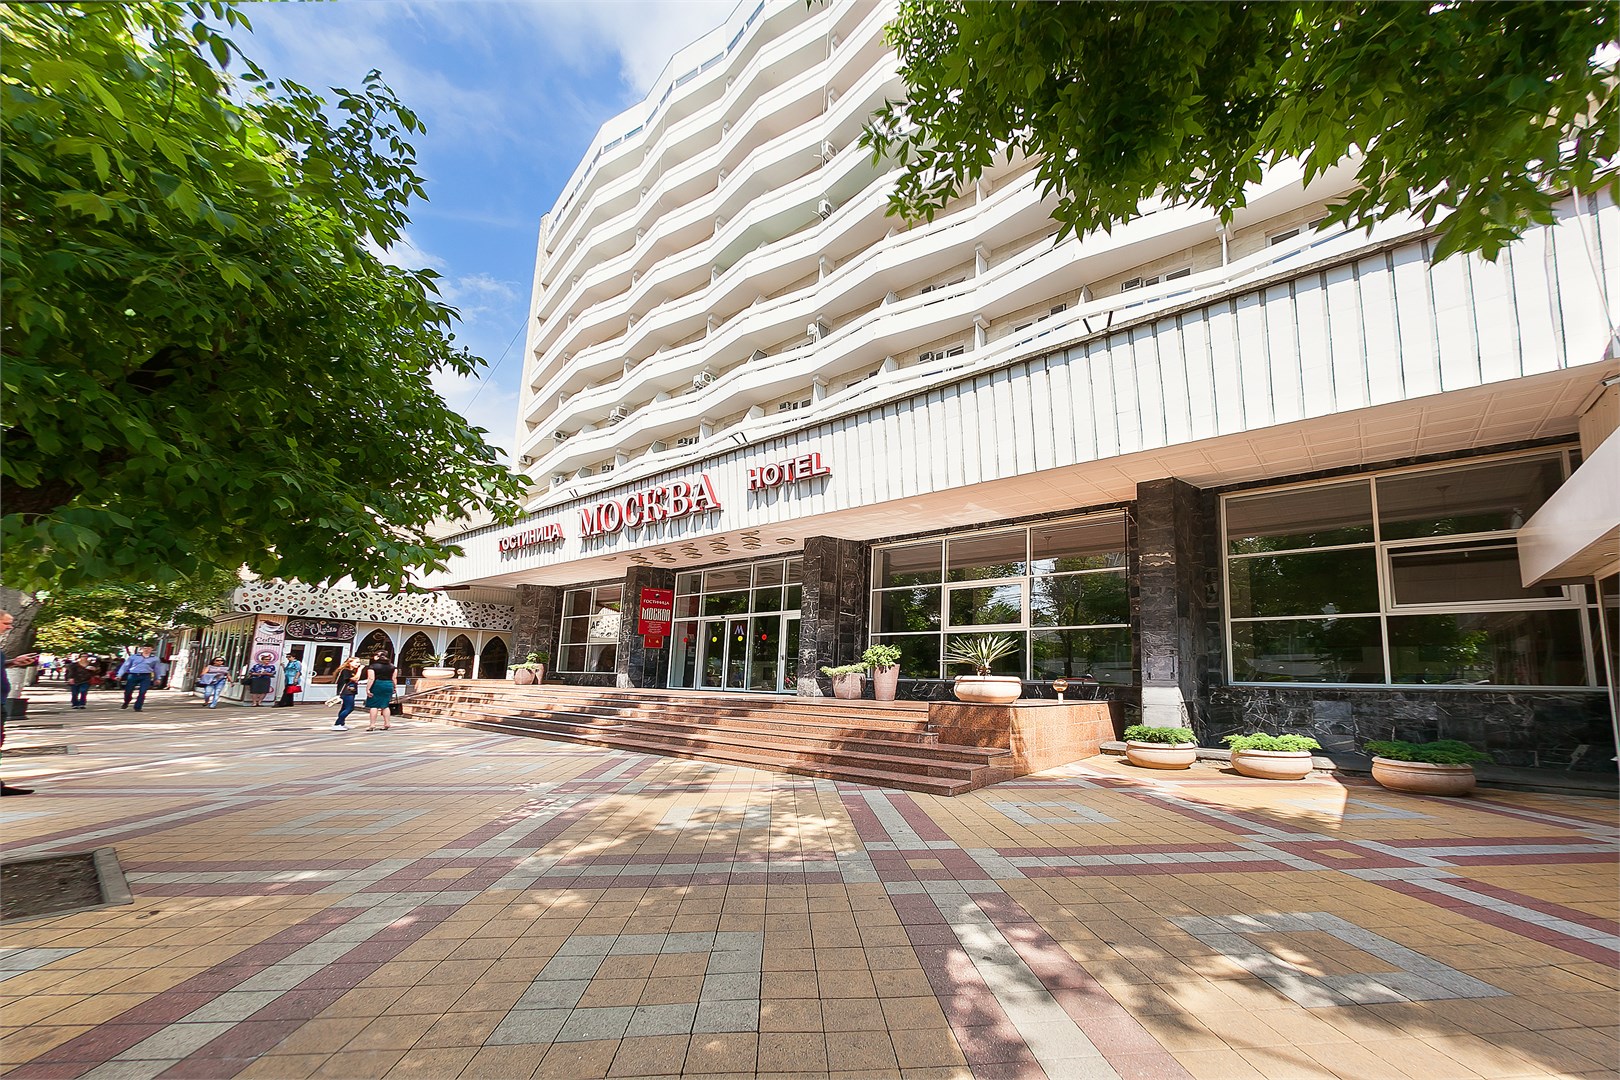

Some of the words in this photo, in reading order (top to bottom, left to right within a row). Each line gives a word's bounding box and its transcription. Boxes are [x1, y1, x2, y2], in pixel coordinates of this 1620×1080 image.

[499, 523, 563, 551] ГОСТИНИЦА
[577, 474, 721, 538] МОСКВА
[747, 452, 830, 490] HOTEL
[641, 607, 671, 622] МОСКВА
